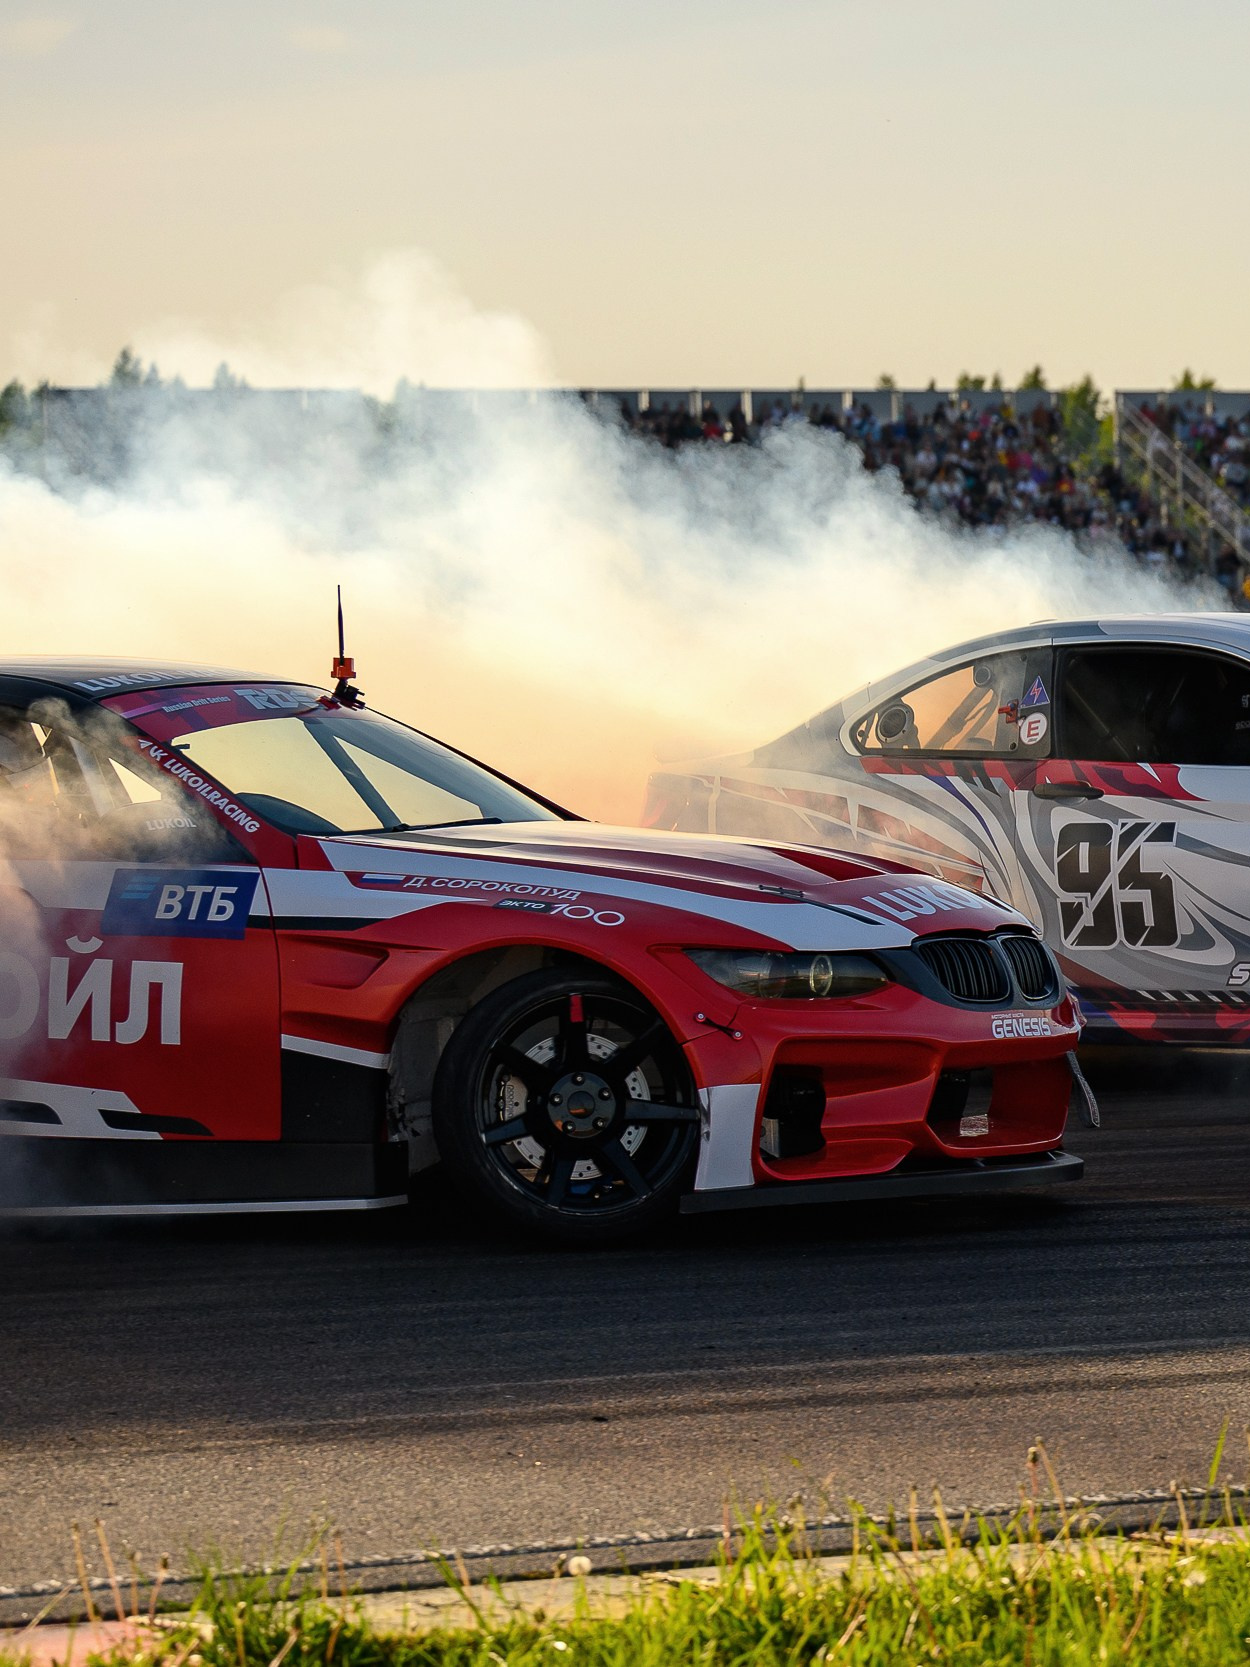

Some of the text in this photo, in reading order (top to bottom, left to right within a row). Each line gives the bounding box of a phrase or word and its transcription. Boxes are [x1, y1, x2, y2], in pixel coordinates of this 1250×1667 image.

[74, 669, 185, 692] LUKOIL
[162, 695, 232, 713] Russian Drift Series
[1027, 719, 1041, 738] E
[164, 758, 261, 833] LUKOILRACING
[146, 817, 197, 831] LUKOIL
[1056, 821, 1179, 947] 95
[155, 885, 239, 921] ВТБ
[550, 903, 626, 927] 100
[991, 1017, 1052, 1039] GENESIS
